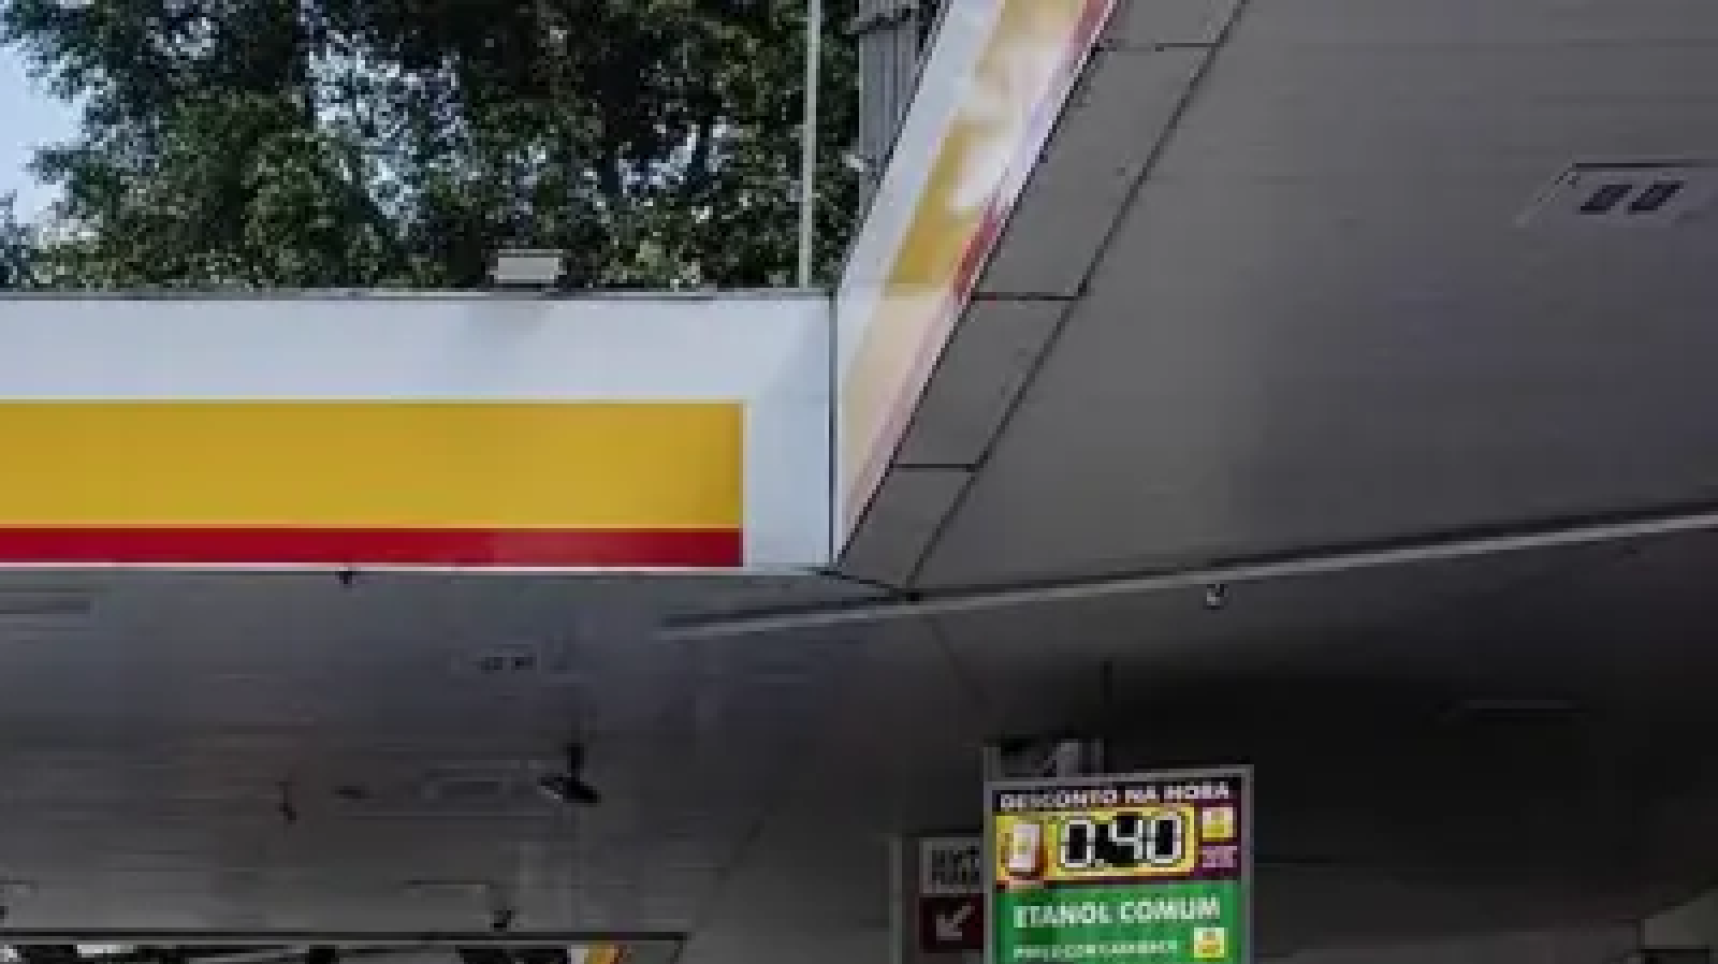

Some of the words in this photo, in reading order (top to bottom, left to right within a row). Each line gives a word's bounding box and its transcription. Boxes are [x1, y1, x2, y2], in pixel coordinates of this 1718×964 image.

[1001, 790, 1119, 810] DESCONTO
[1126, 787, 1159, 804] NA
[1164, 783, 1230, 801] HORA
[1013, 903, 1112, 930] ETANOL
[1118, 897, 1220, 923] COMUM
